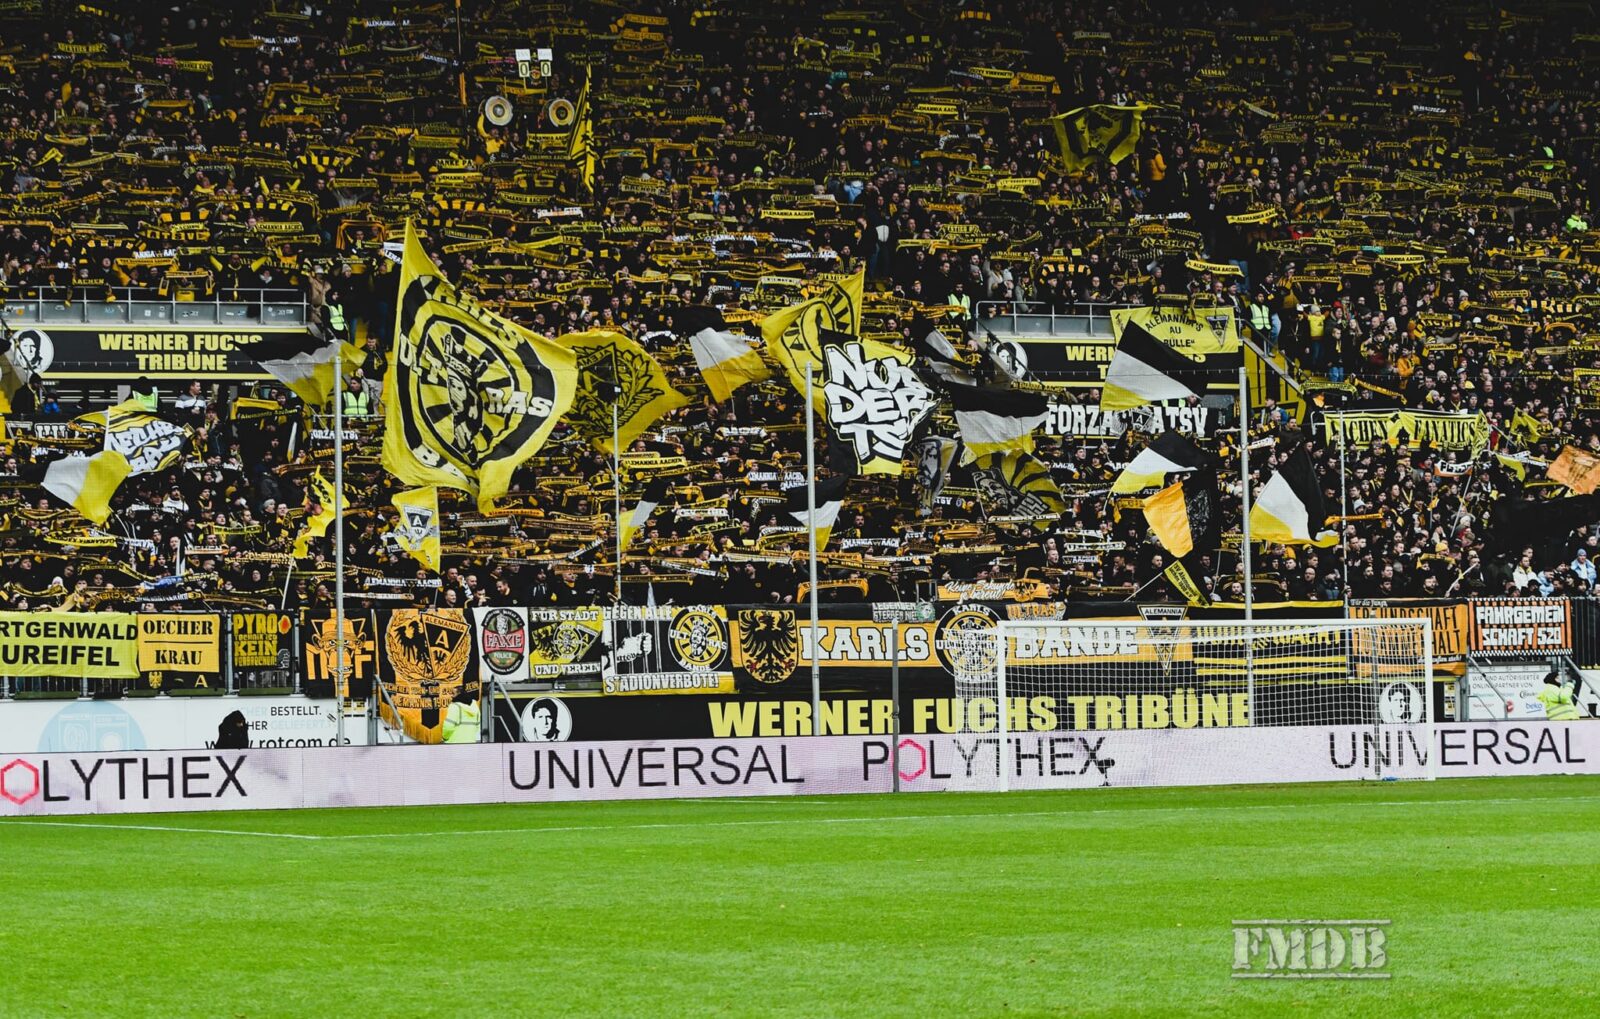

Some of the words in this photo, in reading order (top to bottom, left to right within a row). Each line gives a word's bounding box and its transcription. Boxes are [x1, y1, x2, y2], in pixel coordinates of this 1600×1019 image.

[99, 333, 193, 351] WERNER
[136, 351, 228, 371] TRIBÜNE
[824, 382, 933, 424] DER
[1045, 403, 1114, 436] FORZA
[1414, 419, 1476, 442] FANATICS
[531, 607, 558, 621] FÜR
[559, 609, 600, 622] STADT
[602, 605, 644, 621] GEGEN
[645, 605, 673, 621] ALLE
[952, 604, 990, 616] KARLS
[1006, 602, 1057, 618] ULTRAS
[1475, 605, 1565, 624] FAHRGEMEIN
[143, 620, 213, 635] OECHER
[233, 613, 278, 634] PYRO
[424, 615, 466, 631] ALEMANNIA
[434, 629, 450, 649] A
[486, 634, 523, 649] FAXE
[799, 626, 930, 660] KARLS
[1014, 626, 1140, 659] BANDE
[1482, 627, 1535, 646] SCHAFT
[2, 644, 120, 667] UREIFEL
[155, 650, 203, 665] KRAU
[234, 641, 278, 656] KEIN
[534, 663, 560, 675] UND
[560, 663, 601, 675] VEREIN
[604, 673, 719, 693] STADIONVERBOTE!
[270, 706, 322, 716] BESTELLT.
[708, 699, 894, 737] WERNER
[912, 696, 1058, 734] FUCHS
[1064, 688, 1250, 732] TRIBÜNE
[508, 743, 805, 791] UNIVERSAL
[863, 736, 1106, 782] POLYTHEX
[1329, 727, 1586, 770] UNIVERSAL
